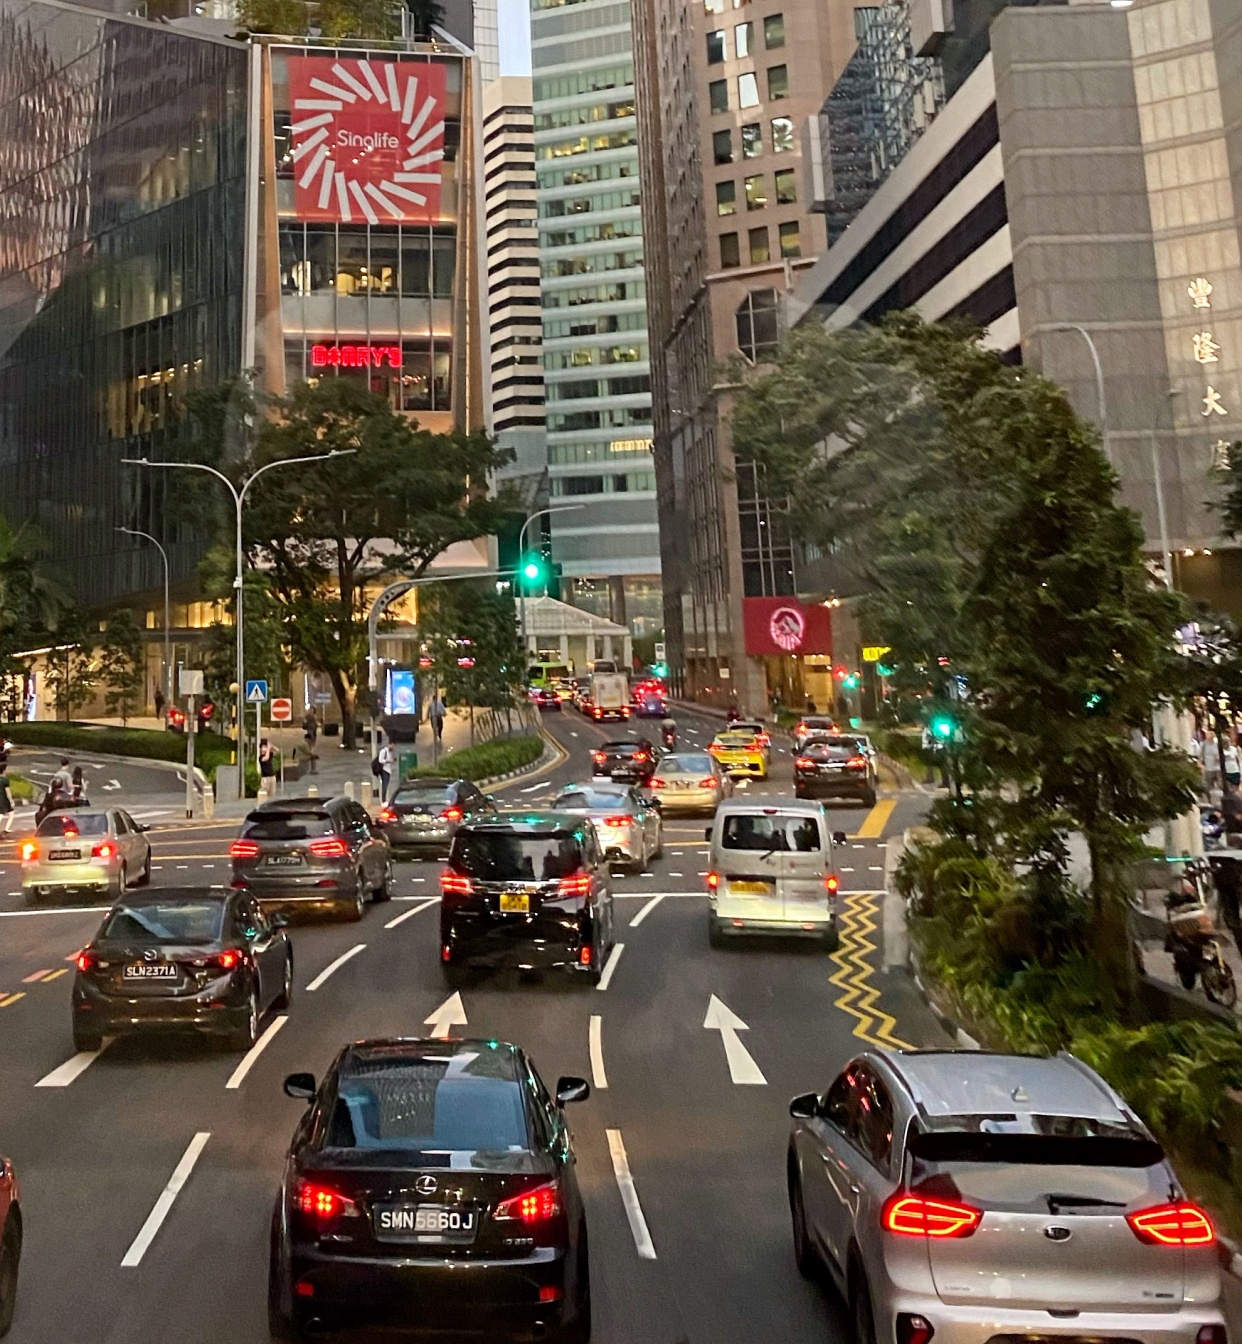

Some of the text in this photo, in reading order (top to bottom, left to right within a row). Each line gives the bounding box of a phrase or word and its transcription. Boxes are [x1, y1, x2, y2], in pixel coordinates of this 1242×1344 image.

[337, 129, 399, 152] Singlife
[126, 965, 176, 976] SLN2371A
[380, 1211, 473, 1230] SMN5660J
